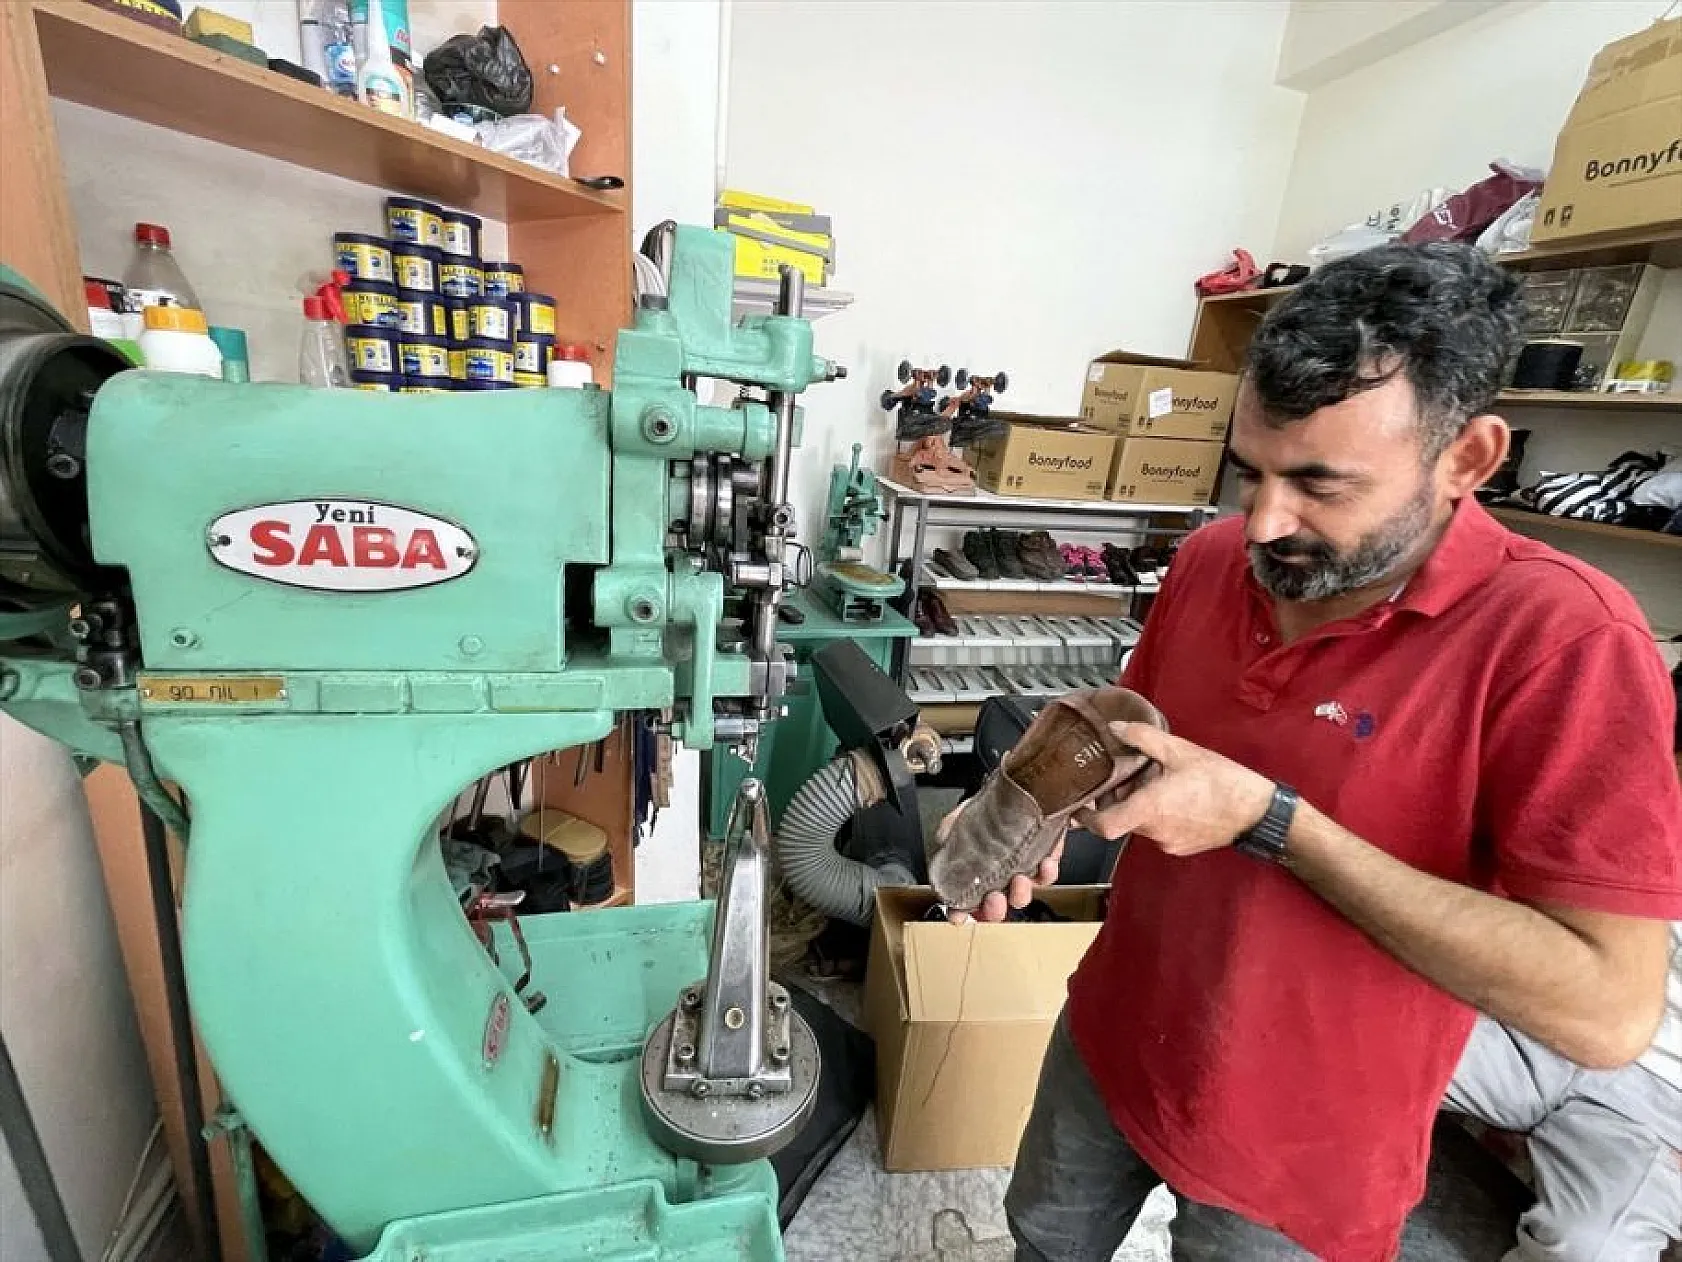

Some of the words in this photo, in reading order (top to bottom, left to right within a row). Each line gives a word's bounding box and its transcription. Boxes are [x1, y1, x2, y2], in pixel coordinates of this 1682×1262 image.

[1172, 394, 1218, 411] nnyfood
[1028, 452, 1093, 470] Bonnyfood
[1140, 463, 1201, 479] Bonnyfood
[315, 503, 375, 524] Yeni
[249, 520, 446, 570] SABA
